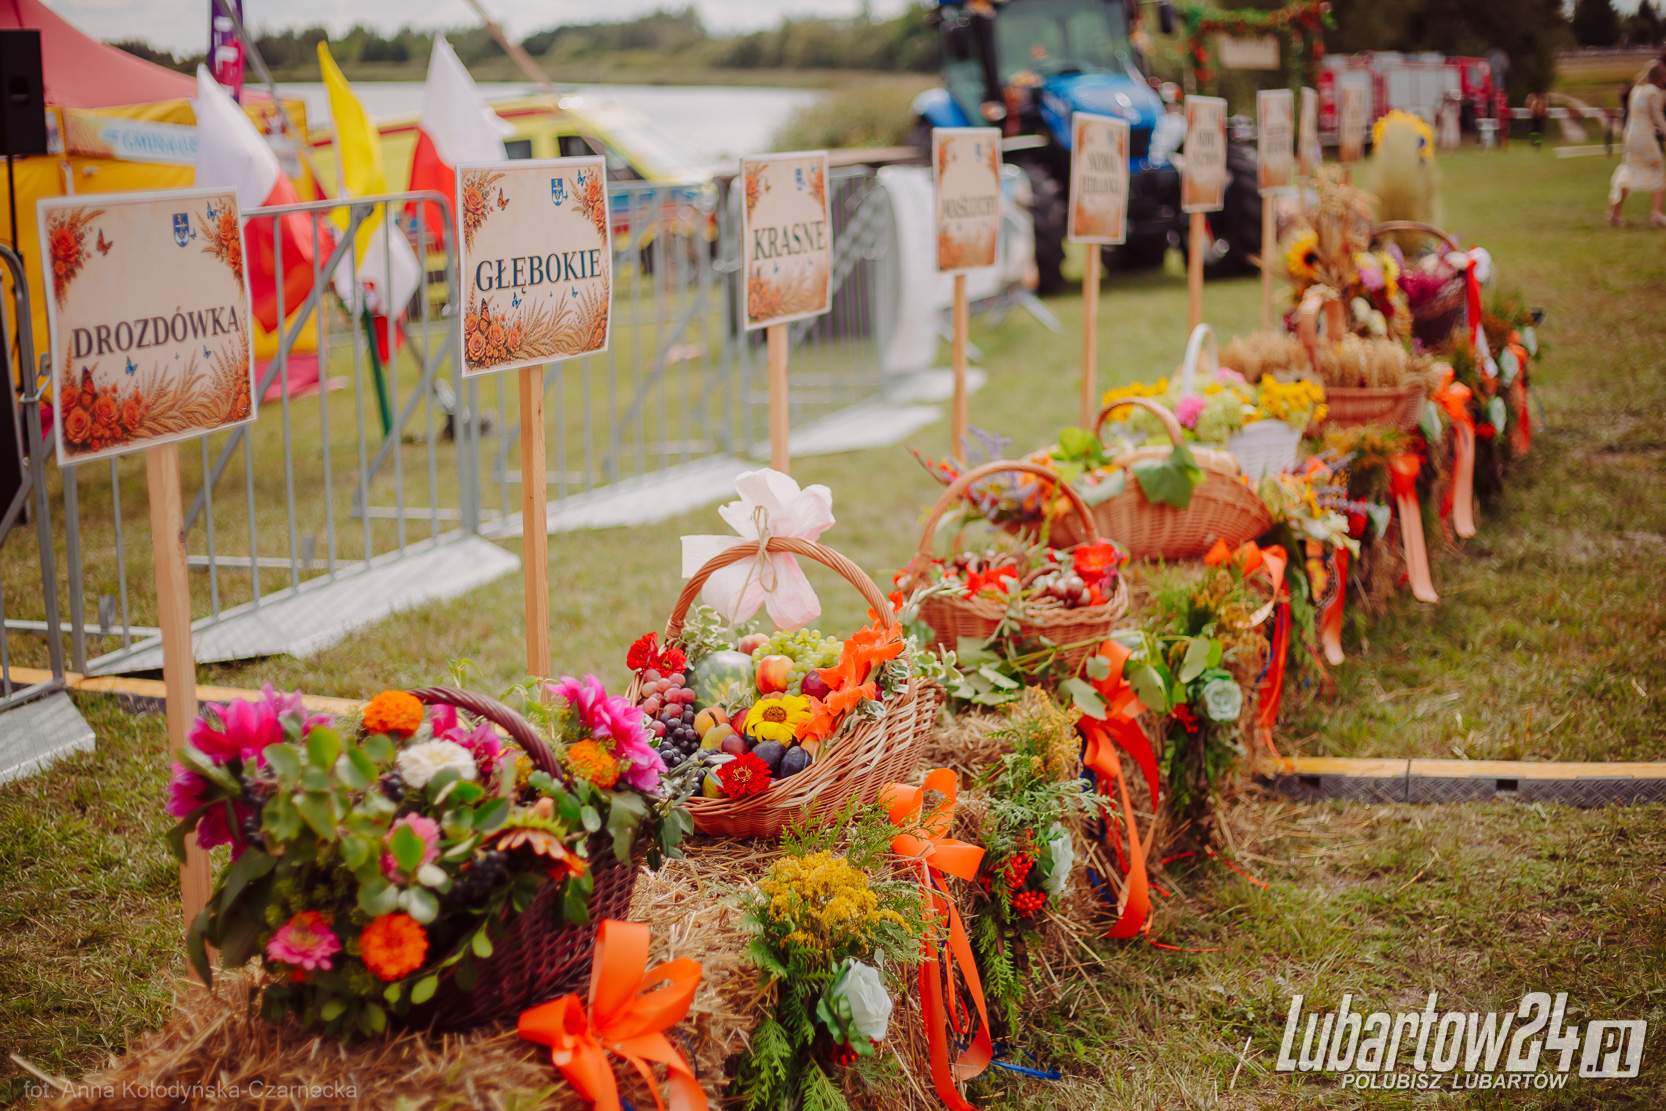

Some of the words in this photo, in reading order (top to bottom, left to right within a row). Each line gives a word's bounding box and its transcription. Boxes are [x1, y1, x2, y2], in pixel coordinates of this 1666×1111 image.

[753, 220, 826, 261] KRASNE
[475, 246, 602, 295] GŁĘBOKIE
[73, 305, 240, 359] DROZDÓWKA
